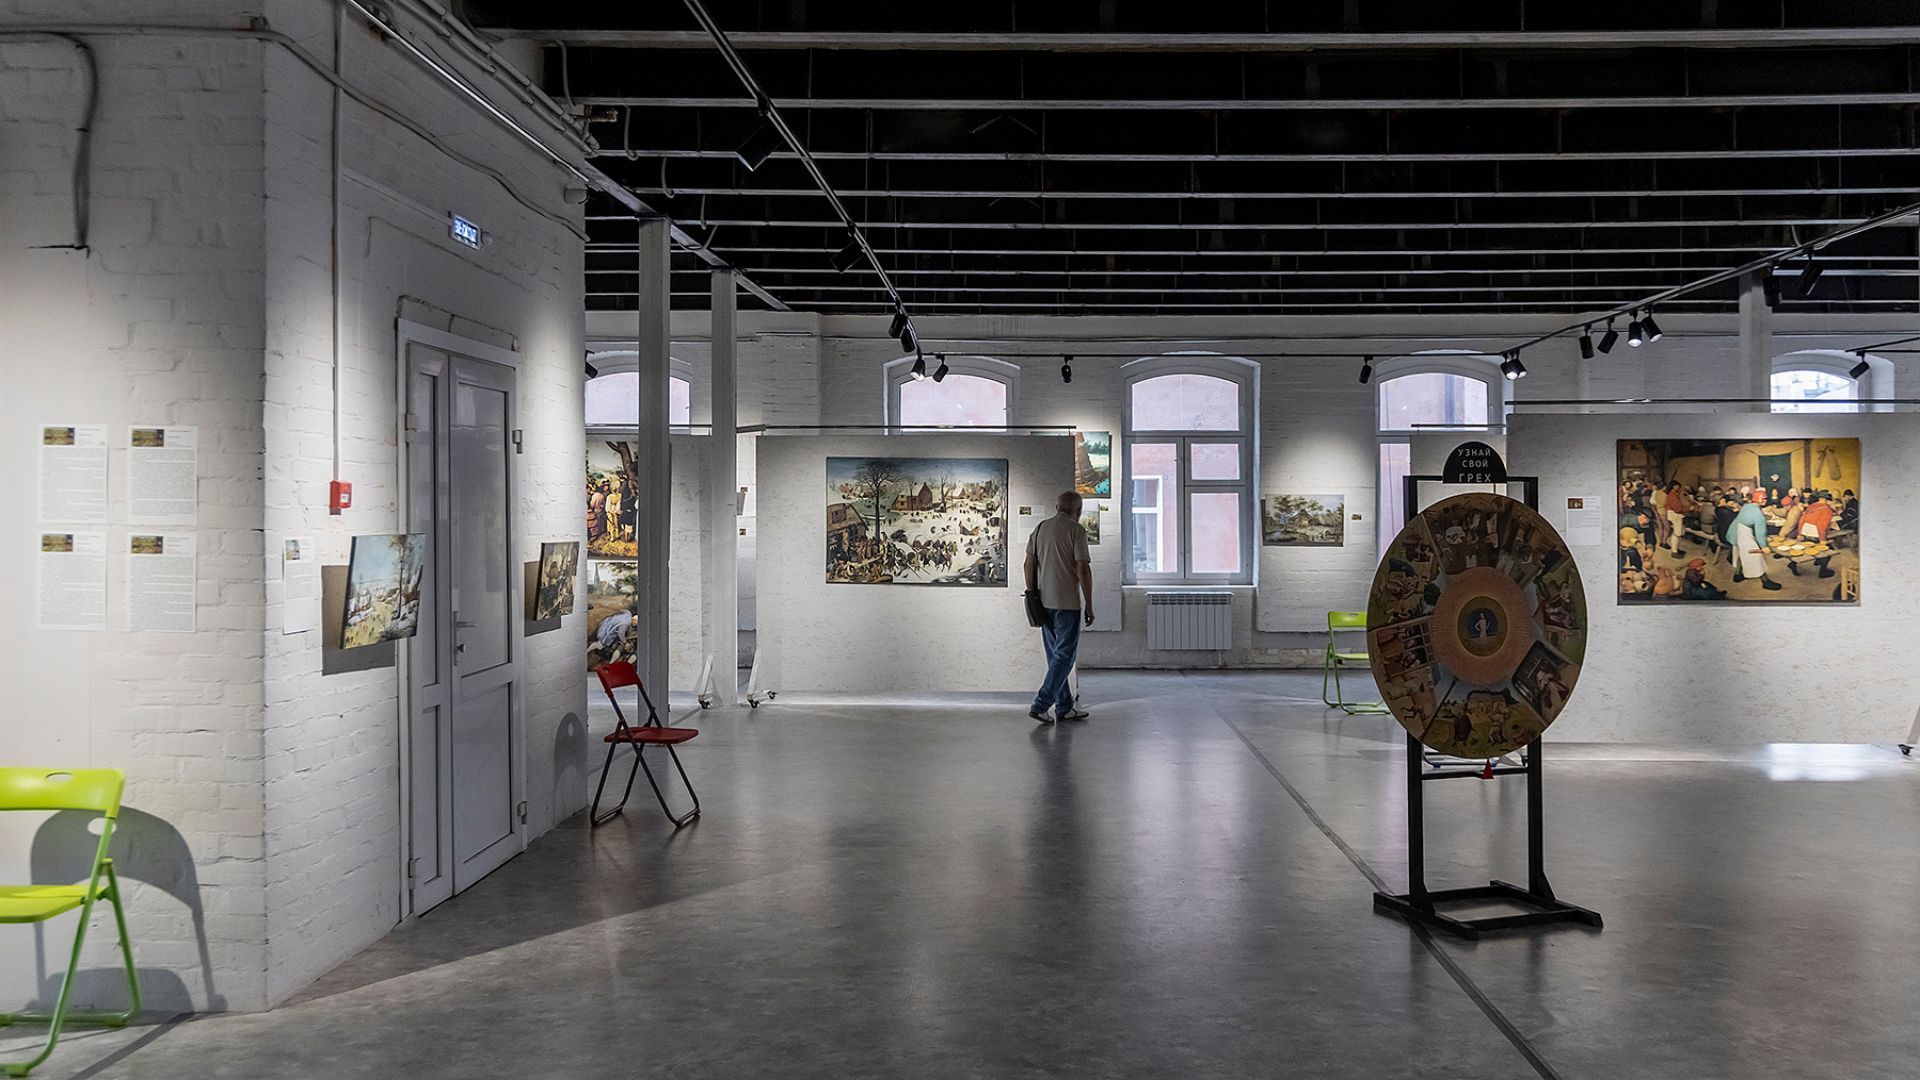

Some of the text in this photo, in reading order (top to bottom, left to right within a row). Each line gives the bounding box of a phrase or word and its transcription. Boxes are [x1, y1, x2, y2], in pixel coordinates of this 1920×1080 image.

[1458, 448, 1491, 457] УЗНАЙ
[1461, 459, 1488, 468] СВОЙ
[1459, 473, 1491, 483] ГРЕХ
